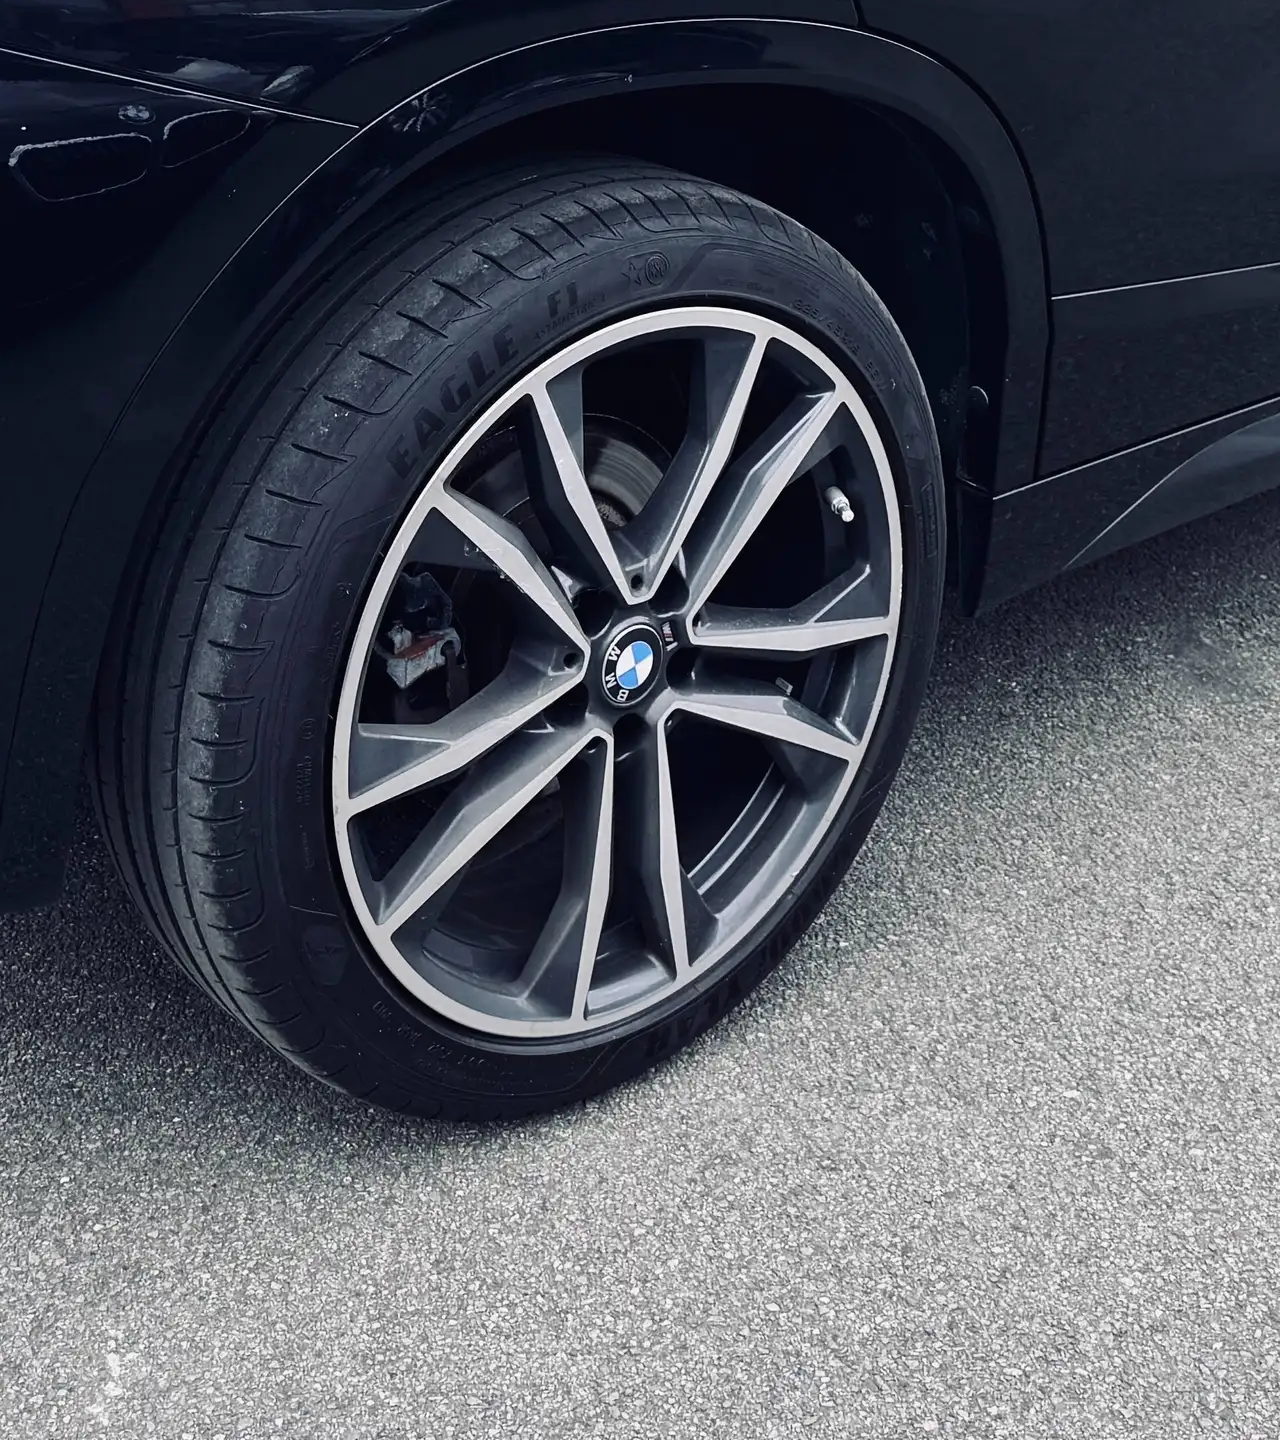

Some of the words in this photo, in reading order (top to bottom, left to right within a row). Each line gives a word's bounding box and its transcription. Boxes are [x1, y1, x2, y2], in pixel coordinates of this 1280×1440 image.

[386, 323, 520, 479] EAGLE
[546, 280, 580, 318] F1
[605, 644, 629, 702] BMW
